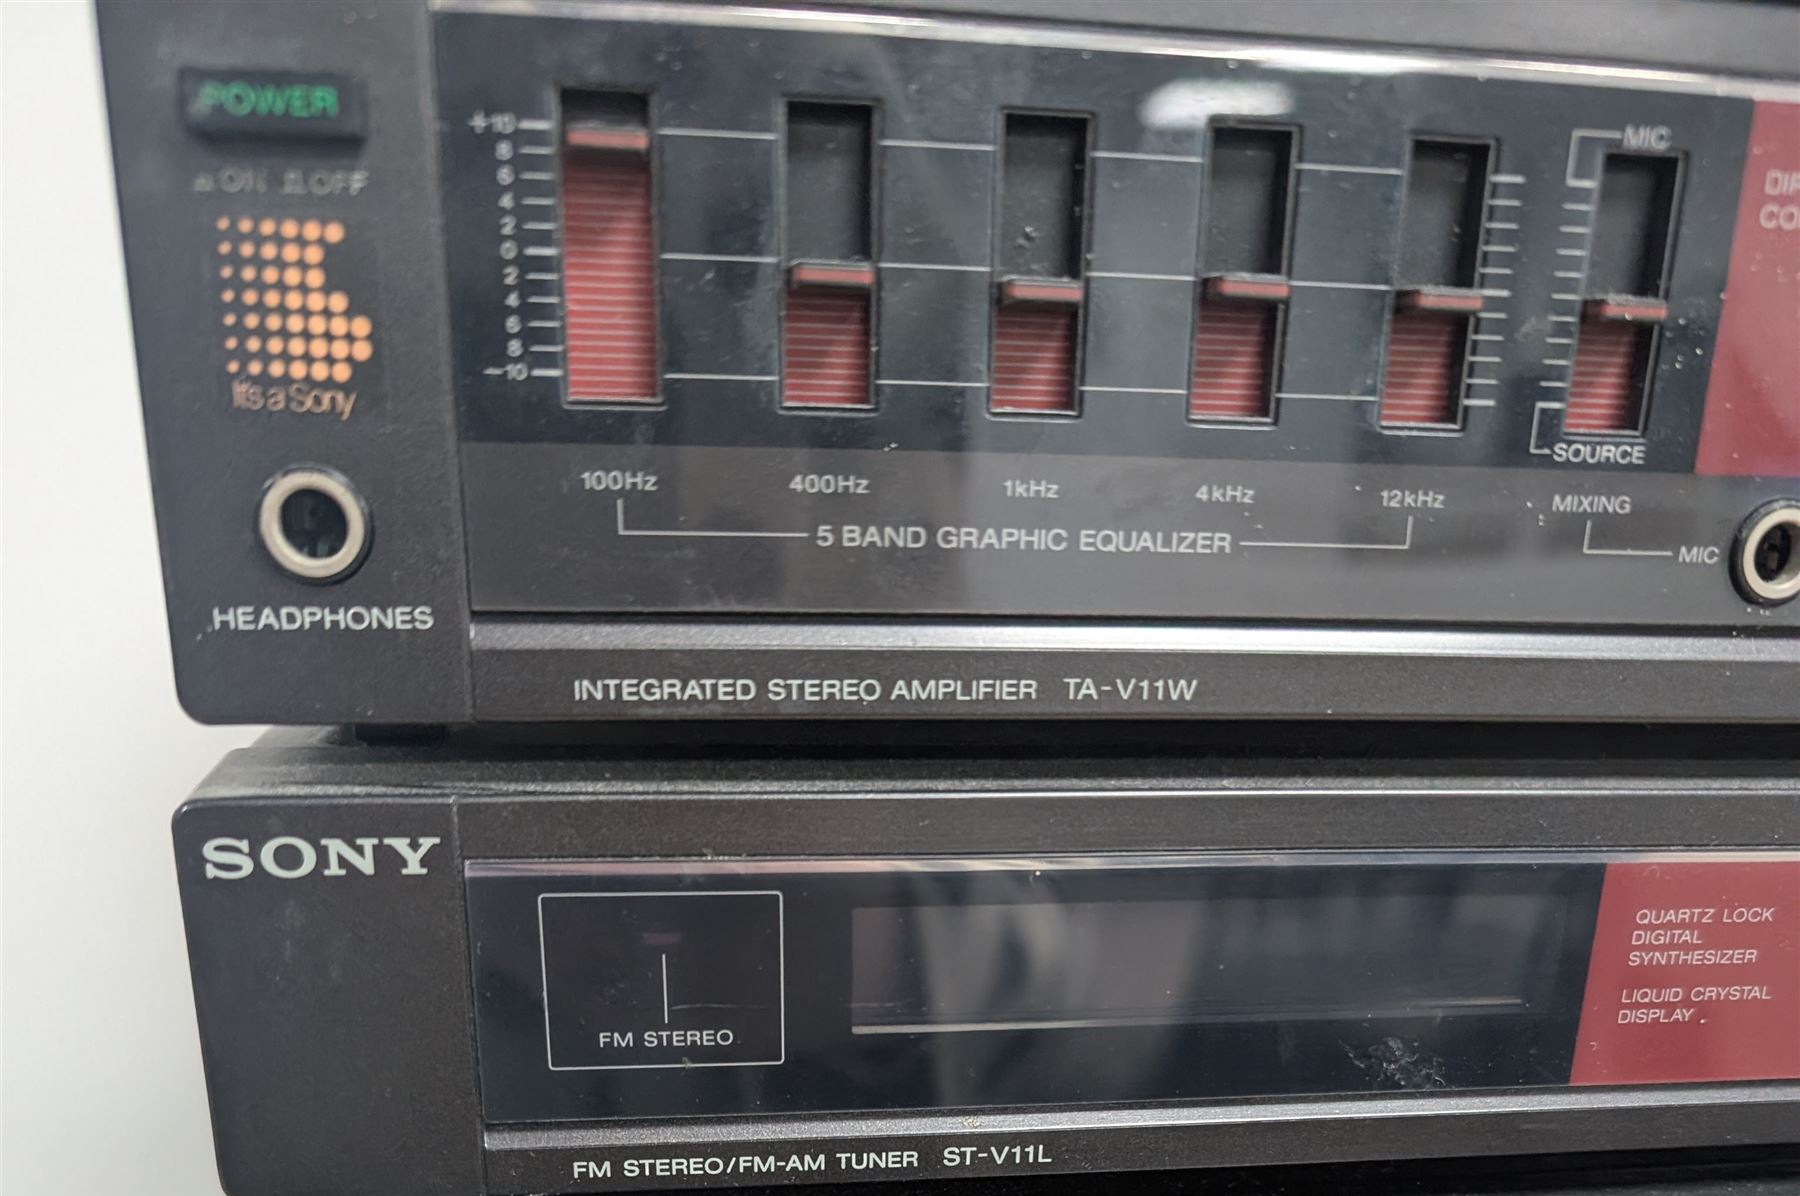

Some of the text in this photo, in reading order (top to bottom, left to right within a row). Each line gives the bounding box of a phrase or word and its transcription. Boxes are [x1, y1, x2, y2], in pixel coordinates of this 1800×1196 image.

[199, 81, 339, 118] POWER
[1622, 125, 1673, 150] MIC
[218, 167, 369, 195] ON OFF
[498, 191, 515, 211] 4
[499, 214, 517, 236] 2
[1759, 203, 1800, 231] CO
[500, 240, 518, 260] 0
[502, 265, 519, 286] 2
[504, 290, 520, 309] 4
[507, 338, 524, 357] 8
[483, 362, 528, 381] -10
[266, 386, 286, 411] a
[288, 381, 358, 421] Sony
[1552, 443, 1646, 464] SOURCE
[580, 470, 658, 492] 100Hz
[788, 473, 871, 496] 400Hz
[1002, 478, 1060, 500] 1kHz
[1195, 485, 1255, 504] 4kHz
[1380, 490, 1445, 509] 12kHz
[1552, 494, 1632, 514] MIXING
[816, 525, 1232, 555] 5 BAND GRAPHIC EQUALIZER
[1678, 546, 1719, 565] MIC
[212, 605, 434, 631] HEADPHONES
[573, 677, 1198, 701] INTEGRATED STEREO AMPLIFIER TA-V11W
[201, 836, 441, 880] SONY
[1635, 907, 1775, 925] QUARTZ LOCK
[1631, 929, 1704, 945] DIGITAL
[1627, 949, 1758, 967] SYNTHESIZER
[1621, 985, 1772, 1004] LIQUID CRYSTAL
[1617, 1008, 1694, 1024] DISPLAY
[598, 1028, 735, 1049] FM STEREO
[573, 1145, 1052, 1179] FM STEREO/FM-AM TUNER ST-V11L
